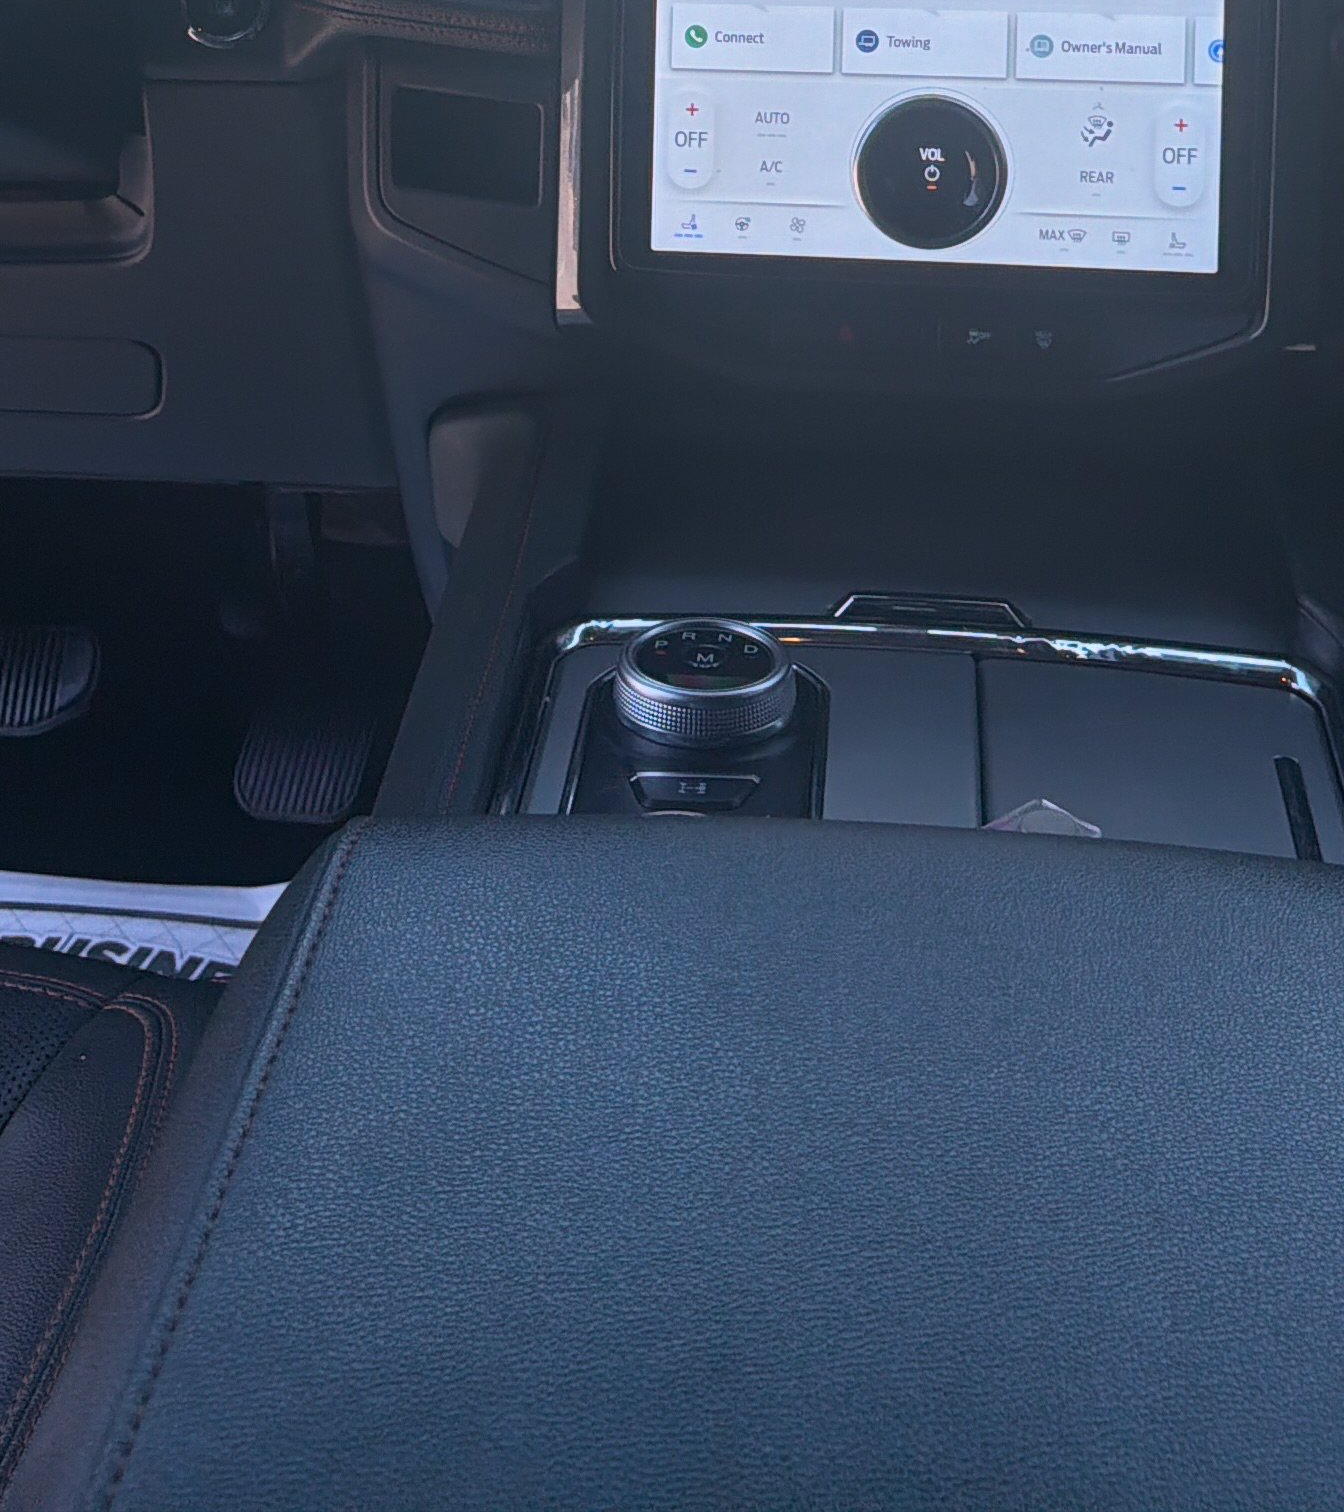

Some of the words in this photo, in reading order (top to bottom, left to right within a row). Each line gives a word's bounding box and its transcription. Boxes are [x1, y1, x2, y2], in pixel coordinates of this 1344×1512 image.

[714, 30, 765, 45] Connect
[886, 35, 931, 52] Towing
[1060, 39, 1112, 56] Owner's
[1114, 40, 1163, 57] Manual
[754, 111, 790, 125] AUTO
[674, 131, 708, 149] OFF
[918, 147, 945, 163] VOL
[1162, 147, 1198, 165] OFF
[759, 159, 783, 175] A/C
[1079, 169, 1115, 184] REAR
[1038, 228, 1066, 241] MAX
[654, 639, 669, 649] P
[681, 631, 697, 641] R
[717, 633, 733, 643] N
[743, 644, 759, 654] D
[696, 652, 714, 663] M
